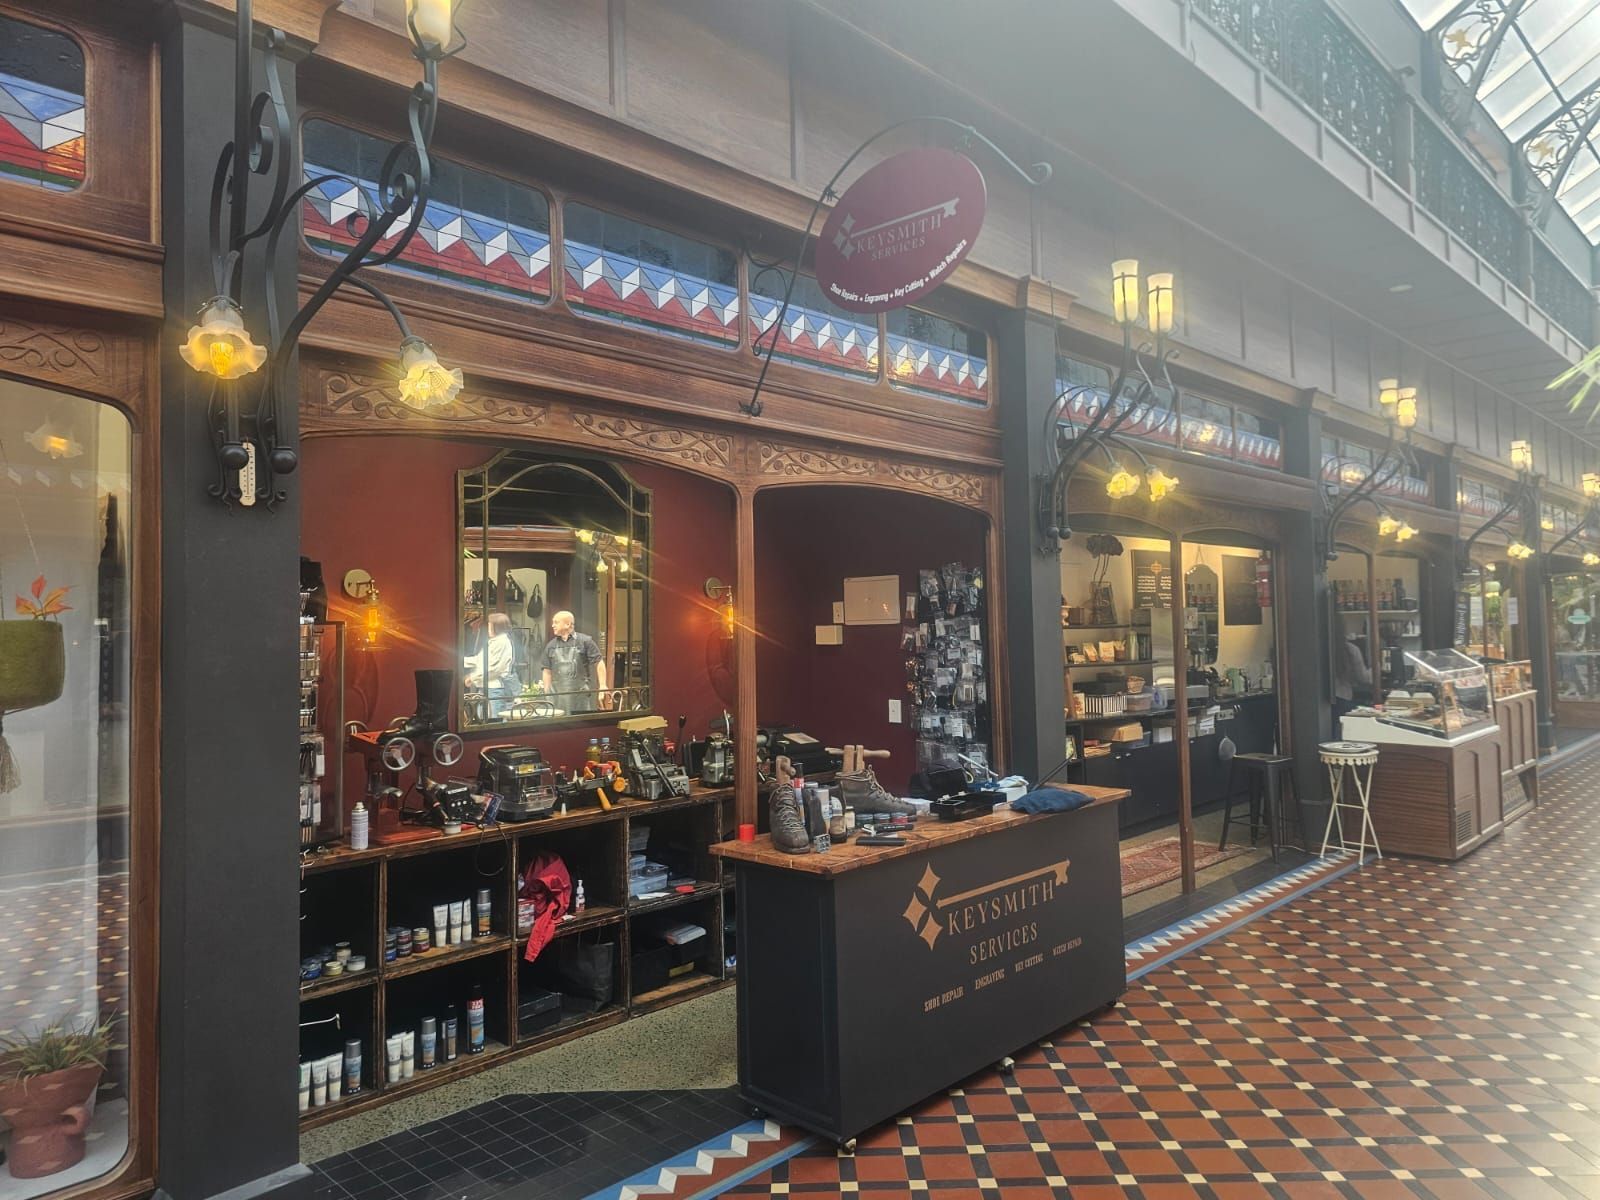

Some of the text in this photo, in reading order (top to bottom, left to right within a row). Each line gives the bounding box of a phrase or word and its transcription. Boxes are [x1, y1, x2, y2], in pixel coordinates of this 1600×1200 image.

[856, 213, 942, 254] KEYSMITH
[871, 236, 926, 262] SERVICES
[830, 282, 842, 296] Shoe
[894, 287, 905, 298] Key
[904, 278, 925, 294] Cutting
[928, 260, 948, 279] Watch
[948, 879, 1054, 936] KEYSMITH
[969, 922, 1039, 965] SERVICES
[924, 996, 940, 1013] SHOE
[941, 986, 964, 1005] REPAIR
[975, 968, 1005, 990] ENGRAVING
